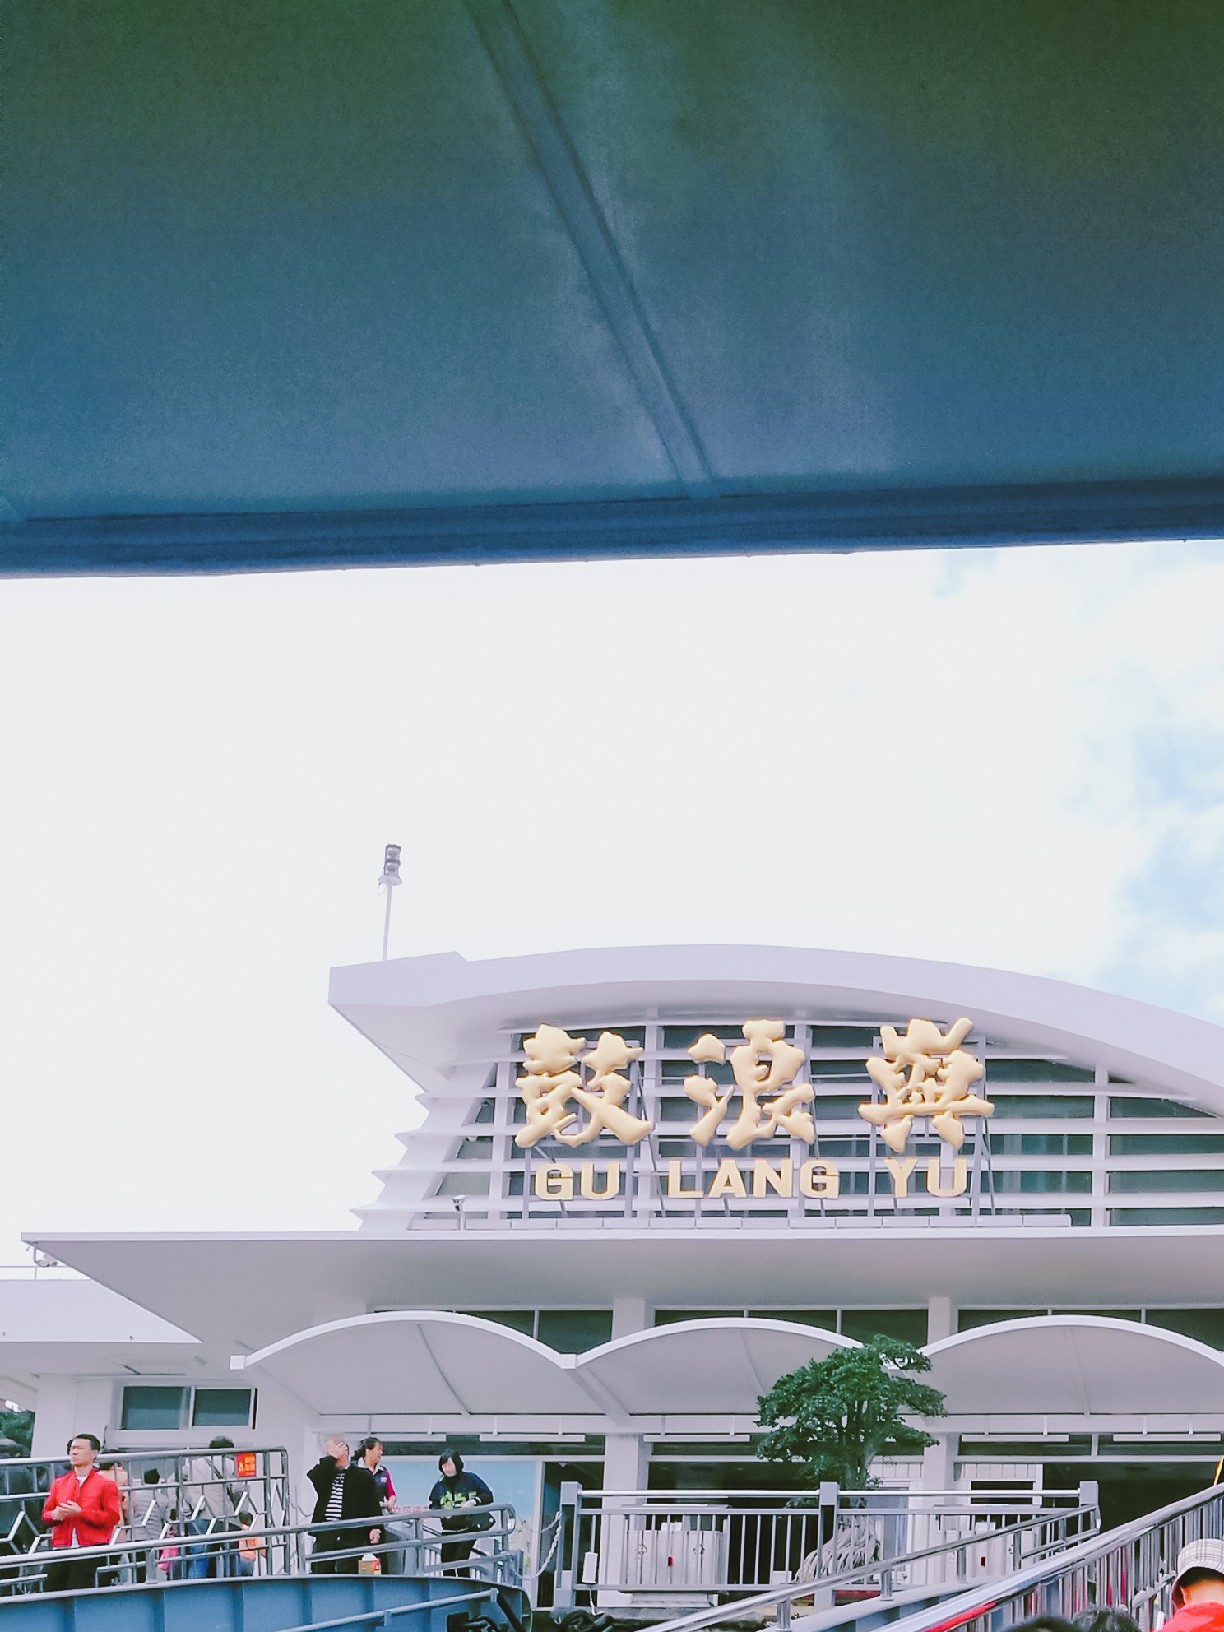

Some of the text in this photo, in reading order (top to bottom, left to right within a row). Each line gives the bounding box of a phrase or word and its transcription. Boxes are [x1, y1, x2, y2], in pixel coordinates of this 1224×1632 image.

[534, 1157, 969, 1201] GU LANG YU
